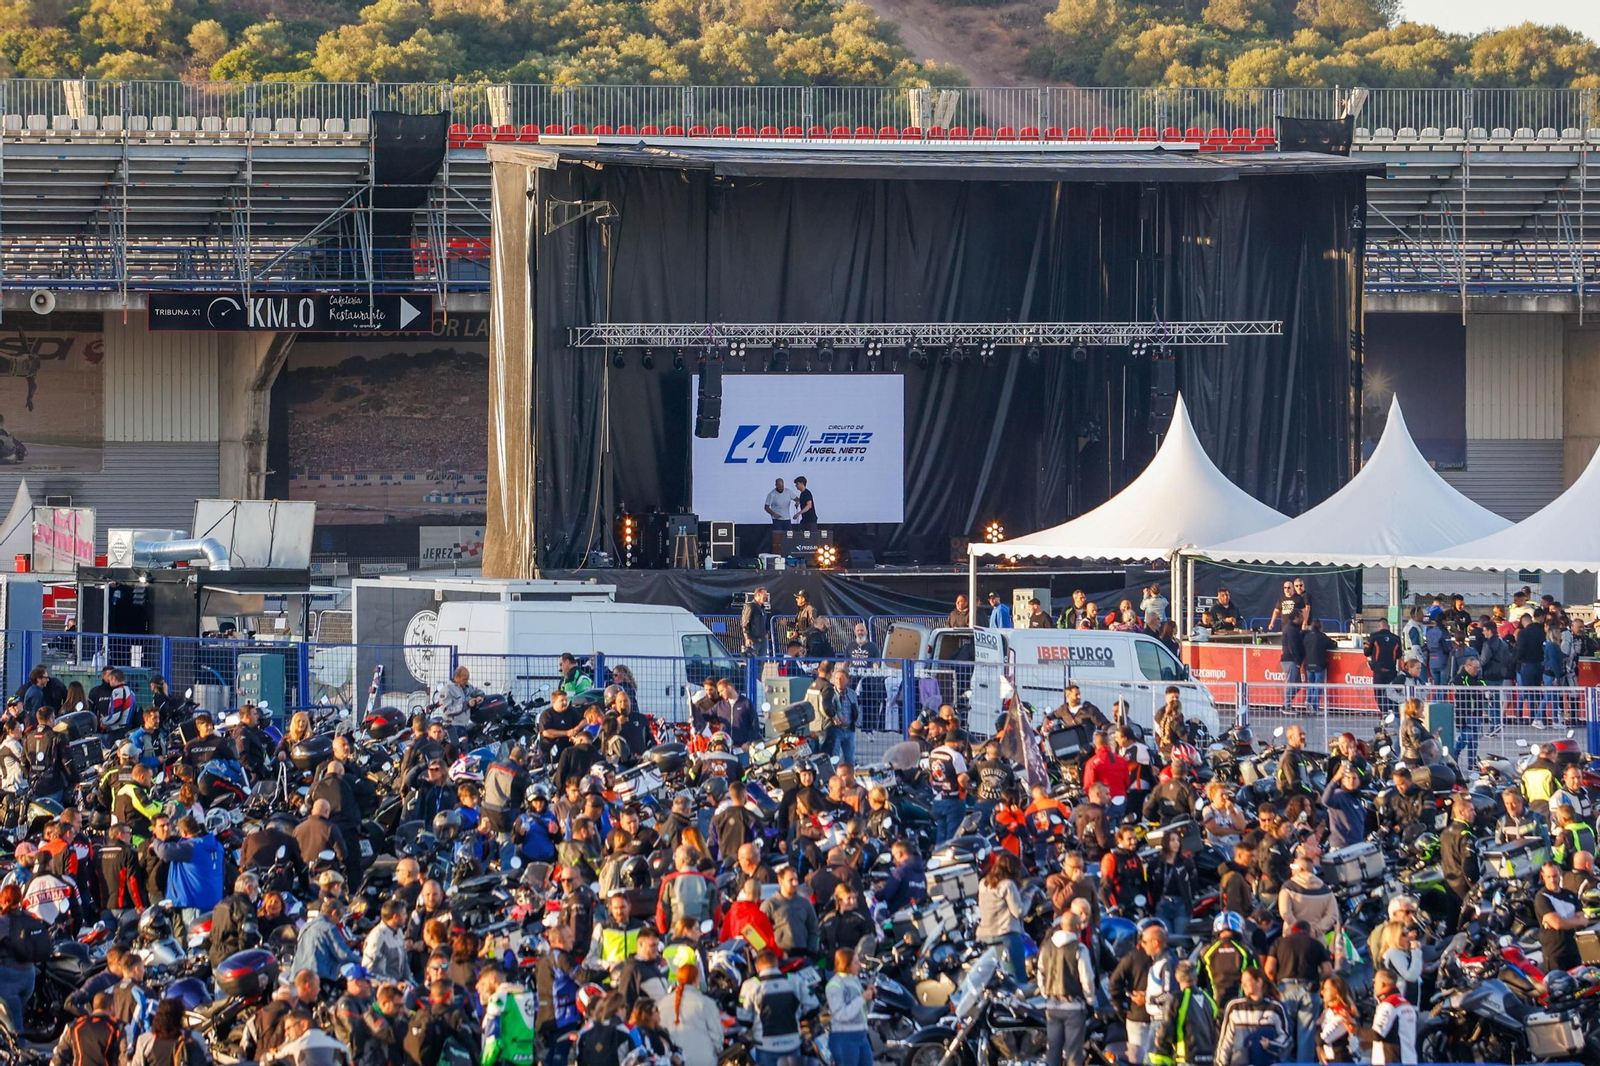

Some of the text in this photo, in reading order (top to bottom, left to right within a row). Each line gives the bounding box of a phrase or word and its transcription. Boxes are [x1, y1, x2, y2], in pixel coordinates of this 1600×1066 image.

[329, 308, 386, 322] Restaurante
[431, 318, 458, 336] OR
[810, 432, 874, 444] JEREZ
[804, 445, 836, 454] ÁNGEL
[422, 548, 454, 562] JEREZ
[1037, 646, 1114, 660] IBERFURGO
[1191, 668, 1226, 679] ruzcampo
[1344, 672, 1374, 684] Cruzca
[30, 889, 65, 905] YAMAHA
